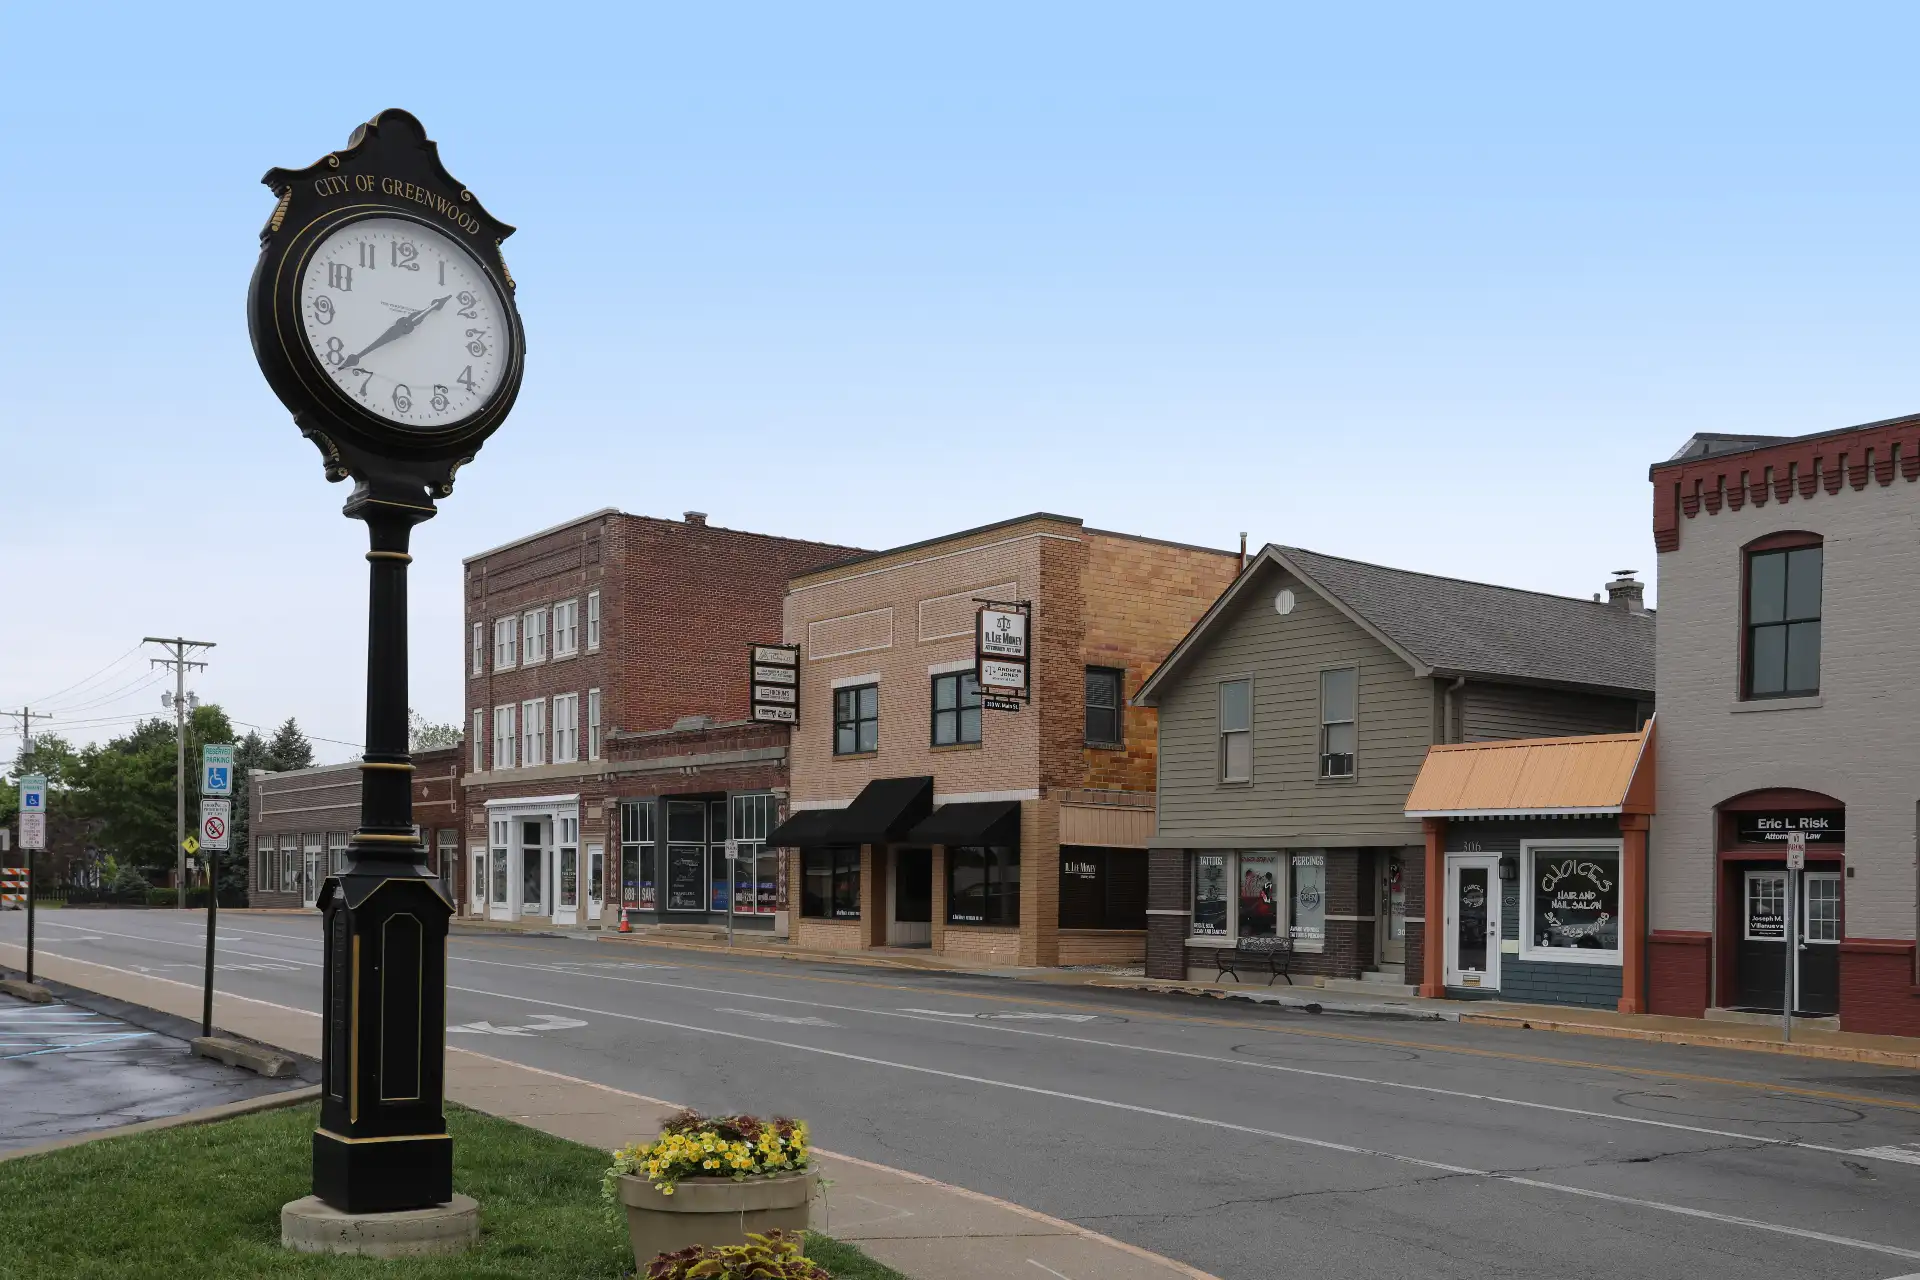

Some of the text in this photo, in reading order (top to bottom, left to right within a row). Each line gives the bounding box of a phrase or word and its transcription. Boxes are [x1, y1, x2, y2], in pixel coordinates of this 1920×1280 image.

[314, 174, 480, 235] CITY OF GREENWOOD
[358, 241, 376, 270] 11
[390, 241, 420, 272] 12
[328, 261, 353, 292] 10
[437, 260, 445, 287] 1
[313, 295, 336, 325] 9
[456, 291, 478, 319] 2
[326, 337, 345, 366] 8
[465, 328, 488, 358] 3
[352, 368, 374, 397] 7
[456, 365, 478, 393] 4
[392, 384, 412, 413] 6
[430, 384, 450, 411] 5
[206, 747, 231, 755] RESERVED
[1758, 817, 1829, 829] Eric L. Risk
[1764, 832, 1821, 840] Attorn Law
[1463, 840, 1481, 852] 306
[1200, 856, 1223, 865] TATTOOS
[1292, 856, 1324, 866] PIERCINGS
[1541, 859, 1613, 893] CHOICES
[1300, 893, 1317, 901] OPEN
[1551, 898, 1602, 910] NAIL SALON
[1557, 889, 1597, 900] HAIR AND
[1751, 915, 1774, 923] Joseph
